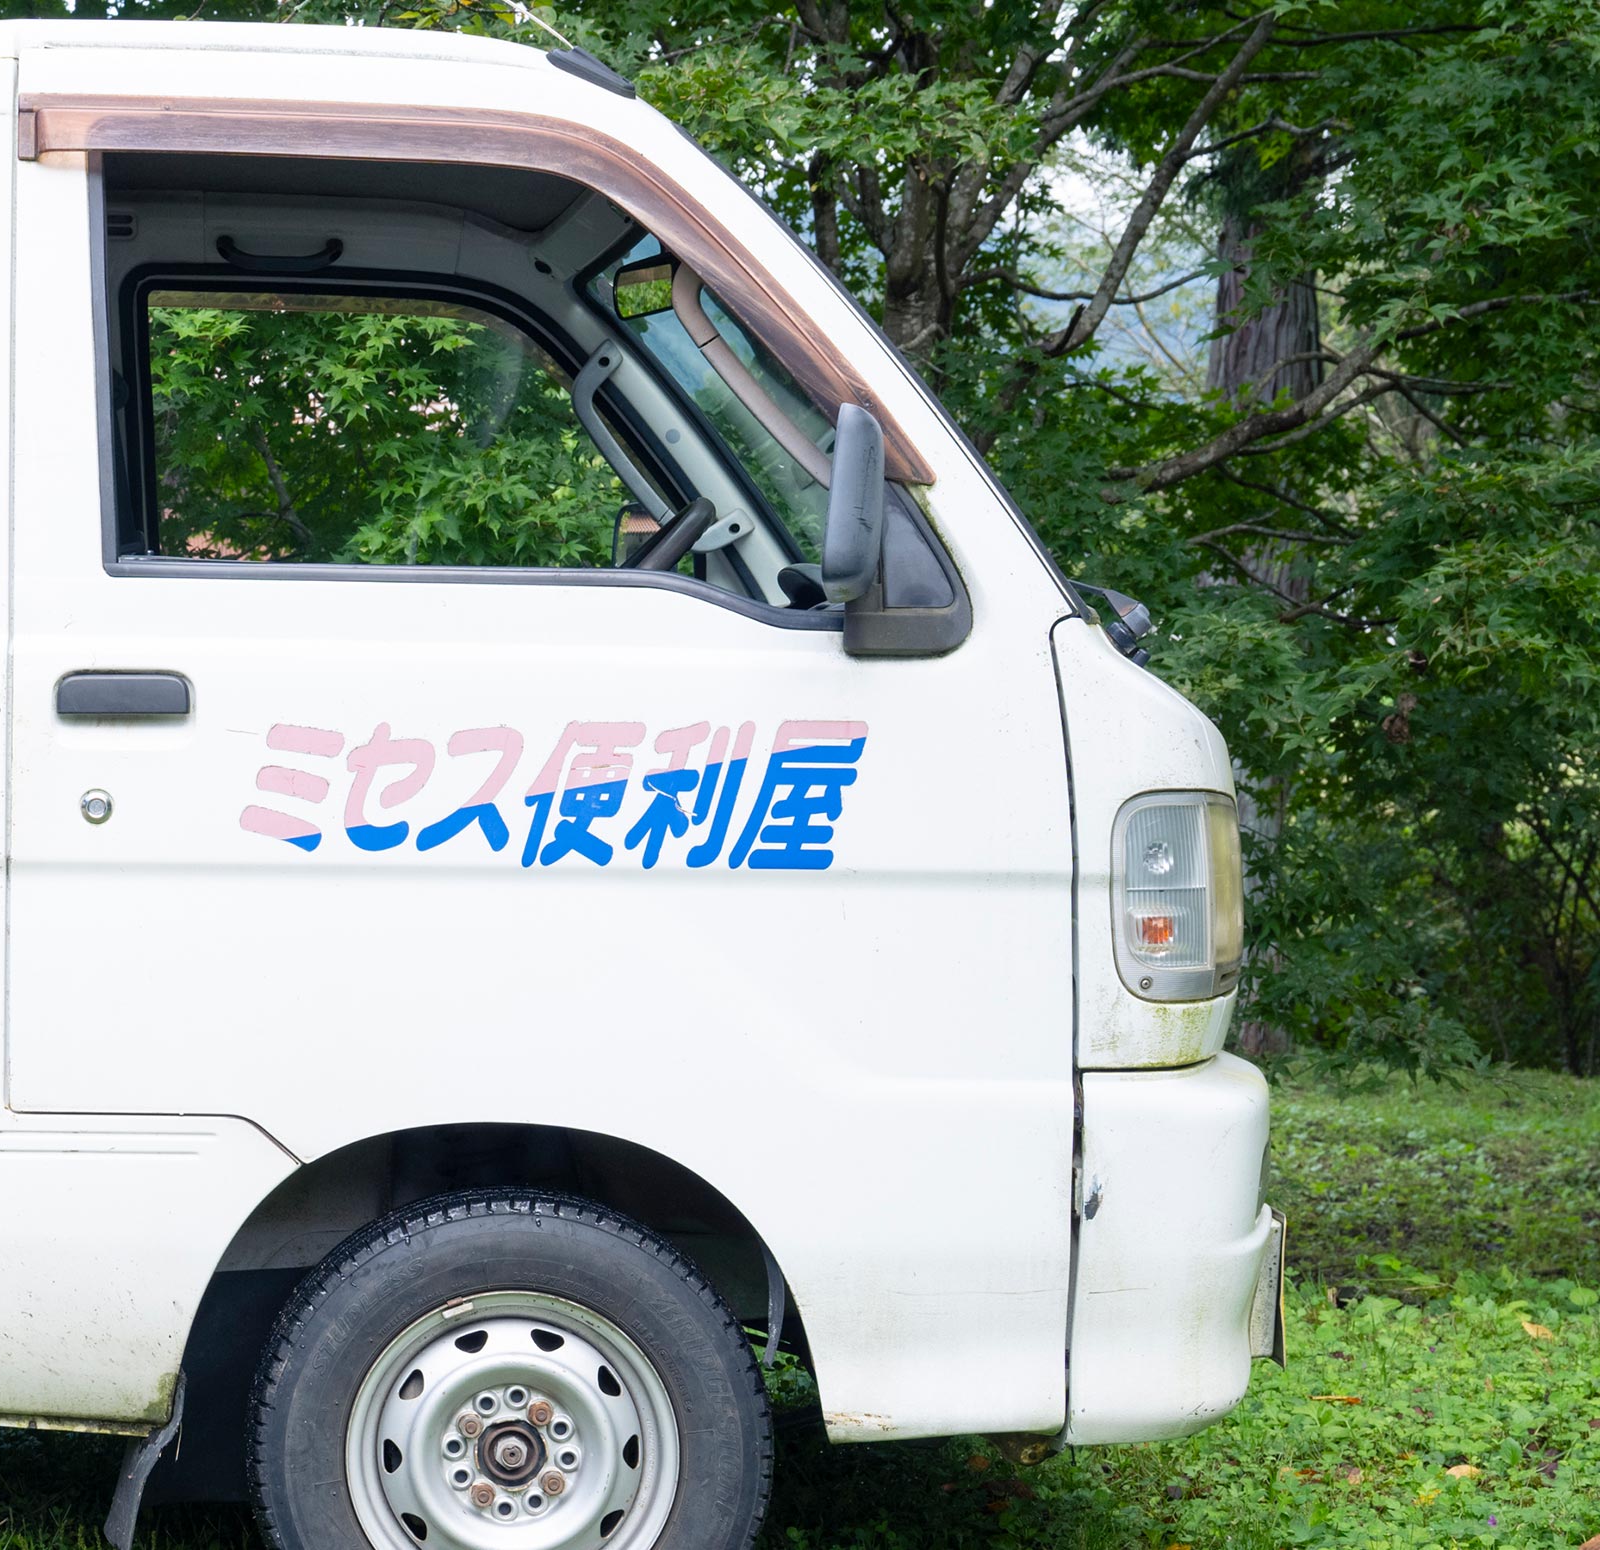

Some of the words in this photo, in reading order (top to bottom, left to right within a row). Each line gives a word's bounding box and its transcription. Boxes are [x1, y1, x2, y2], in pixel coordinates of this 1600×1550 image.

[239, 720, 869, 870] ミセス便利屋
[313, 1257, 425, 1376] STUDLESS
